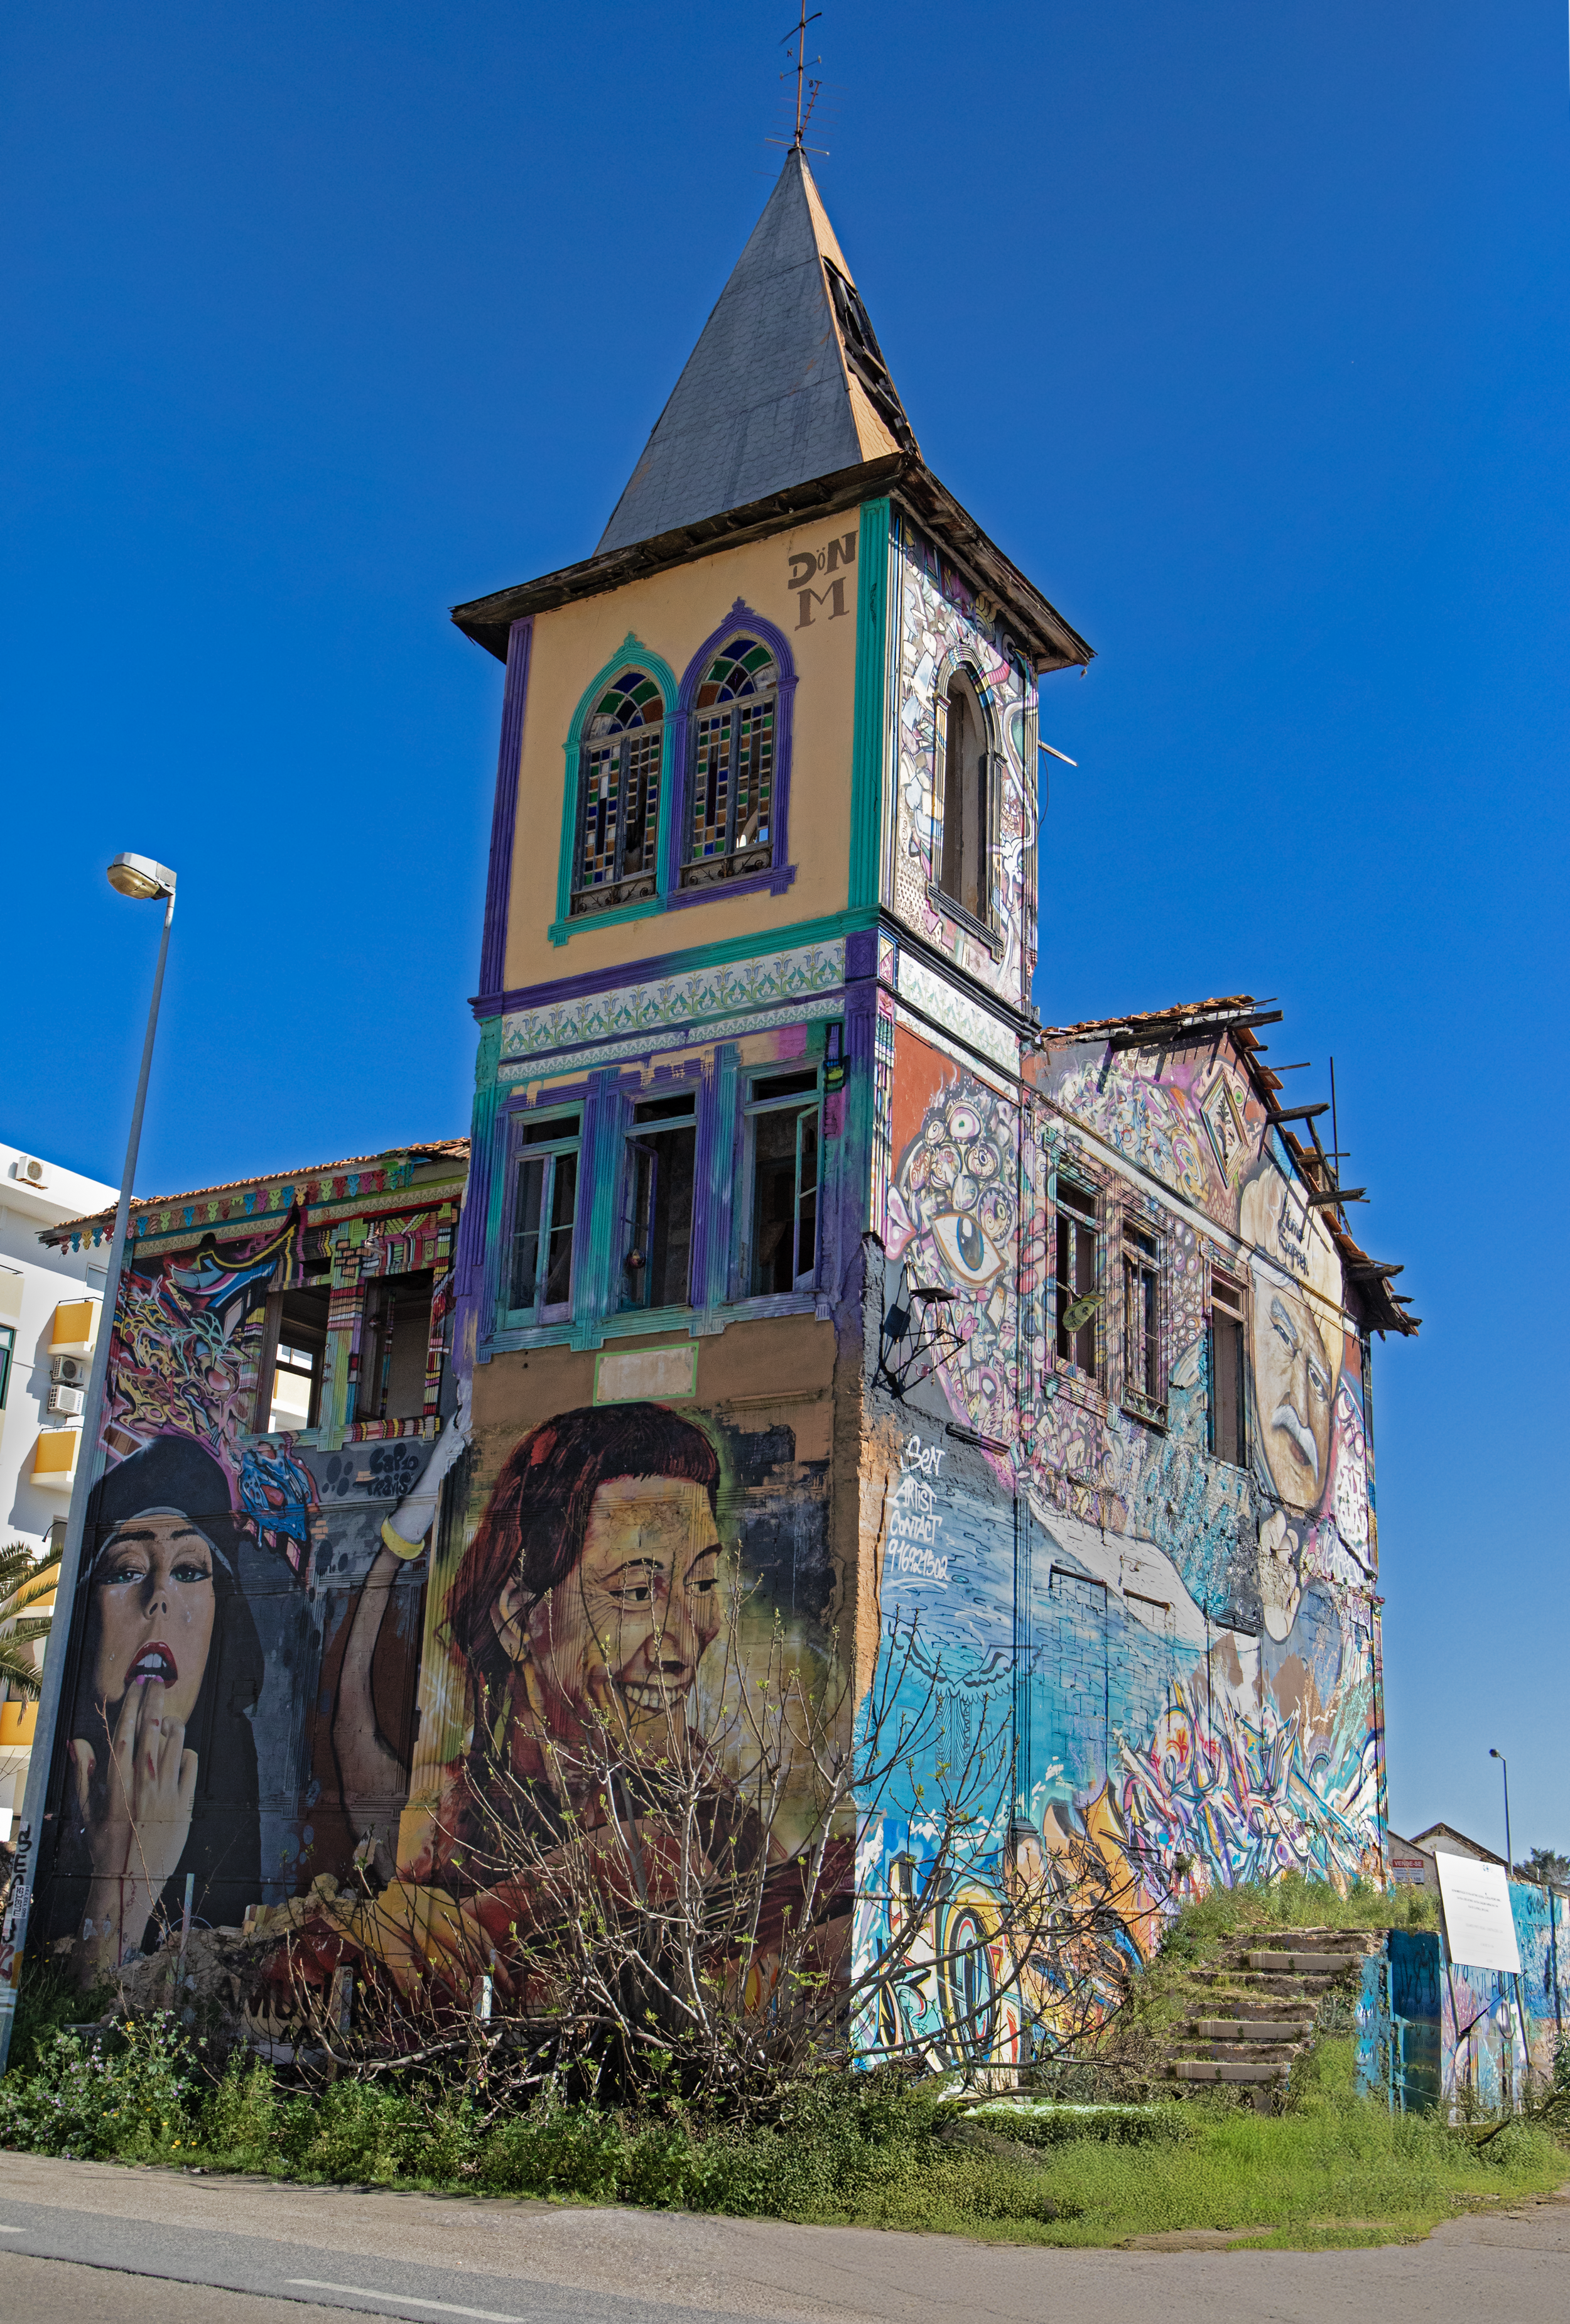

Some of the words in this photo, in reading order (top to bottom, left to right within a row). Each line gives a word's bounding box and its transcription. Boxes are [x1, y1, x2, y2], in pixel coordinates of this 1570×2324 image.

[794, 576, 850, 632] M
[885, 1474, 938, 1516] ARTIST
[888, 1538, 949, 1582] 916921502
